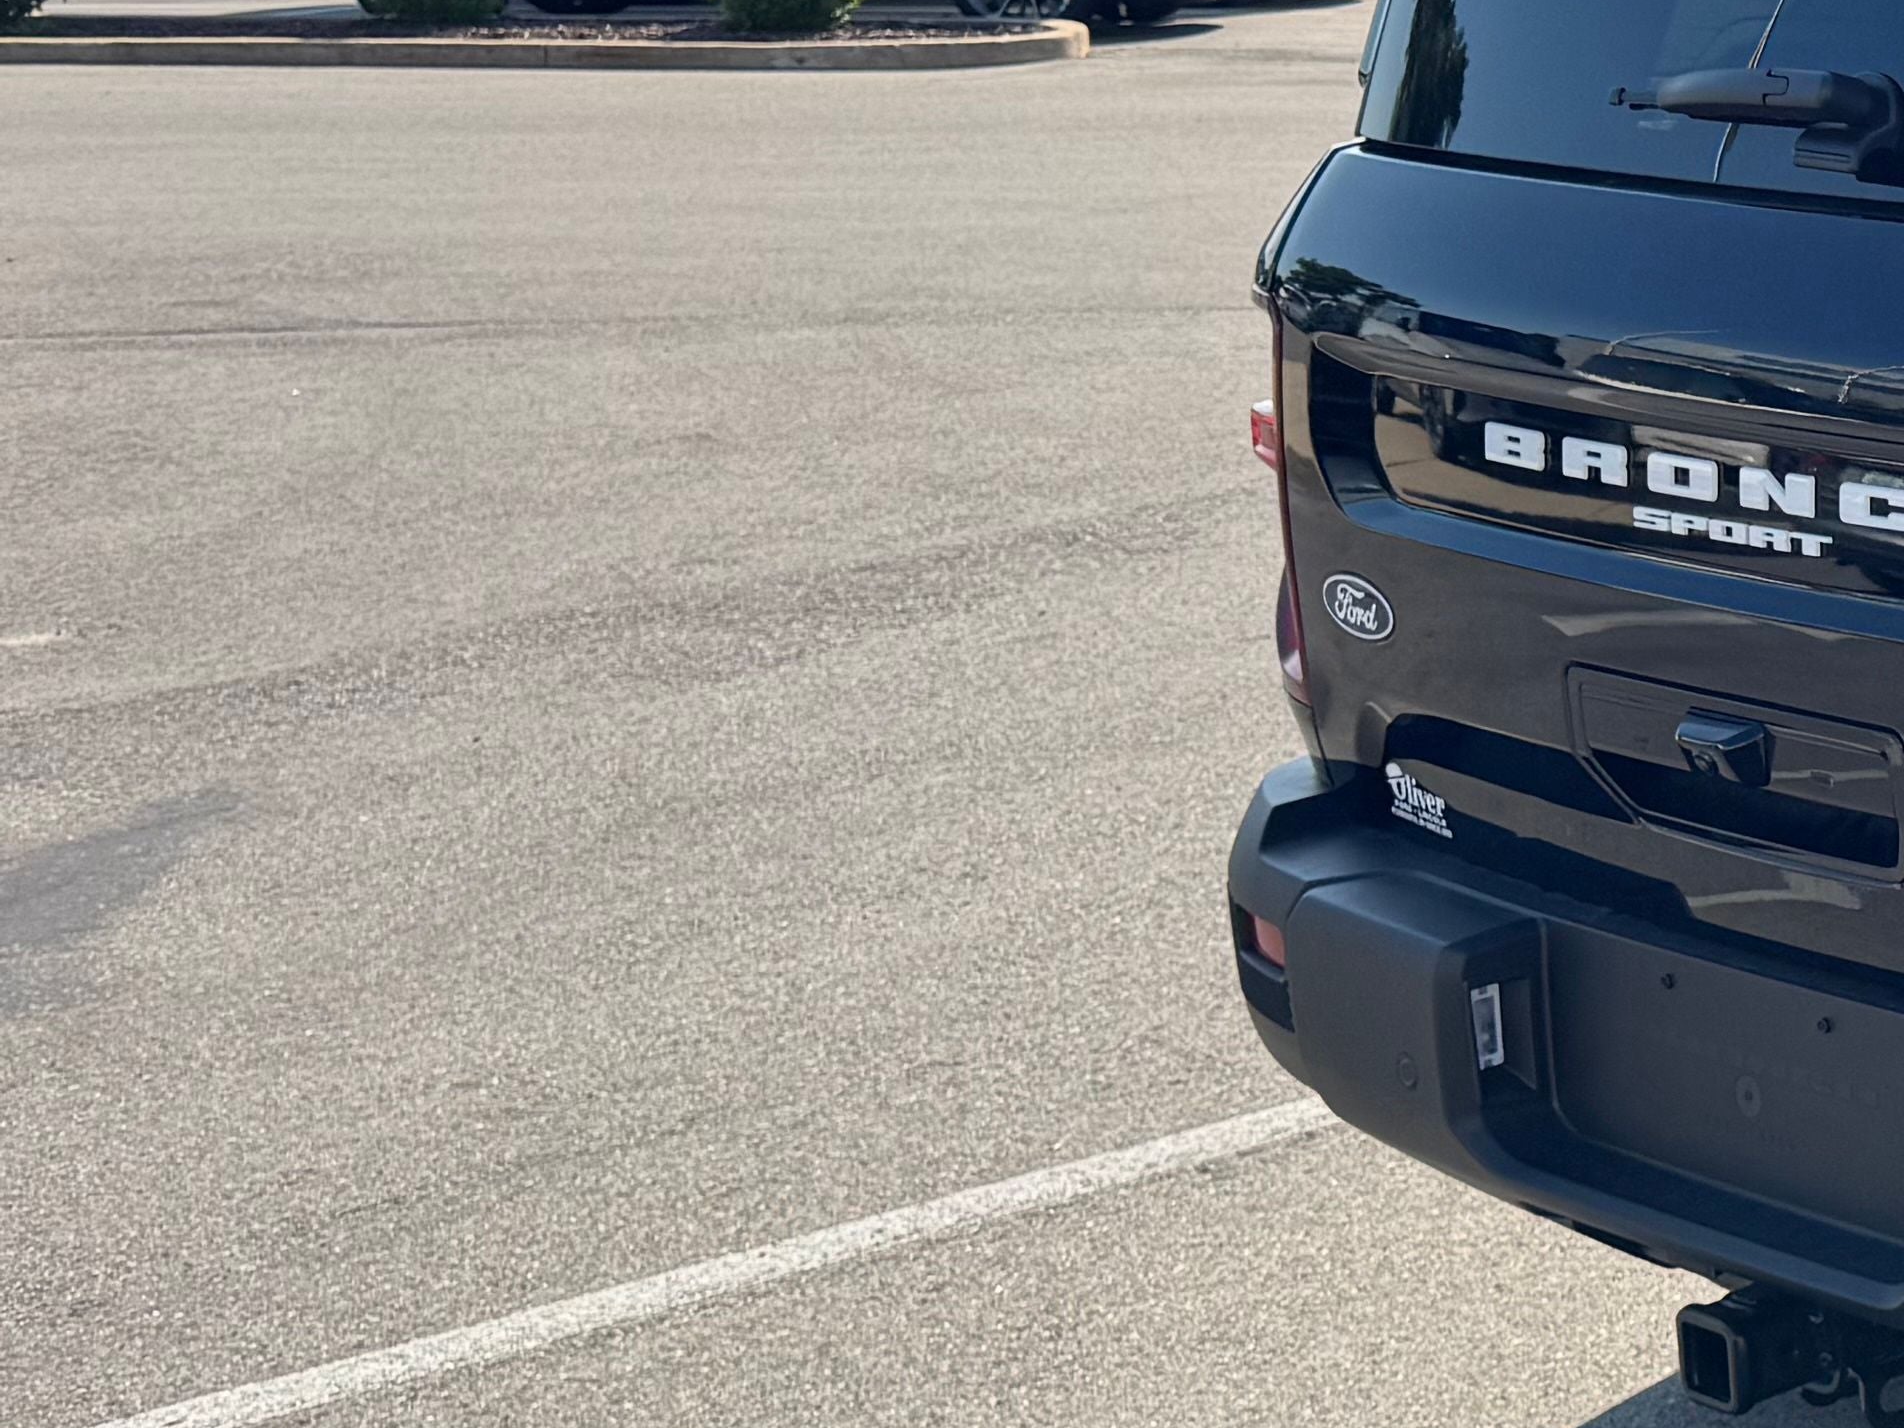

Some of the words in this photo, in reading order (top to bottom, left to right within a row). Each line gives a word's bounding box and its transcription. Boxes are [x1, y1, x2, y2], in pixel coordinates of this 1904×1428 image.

[1632, 505, 1834, 557] SPORT
[1334, 582, 1379, 632] Ford
[1387, 774, 1446, 818] Oliver
